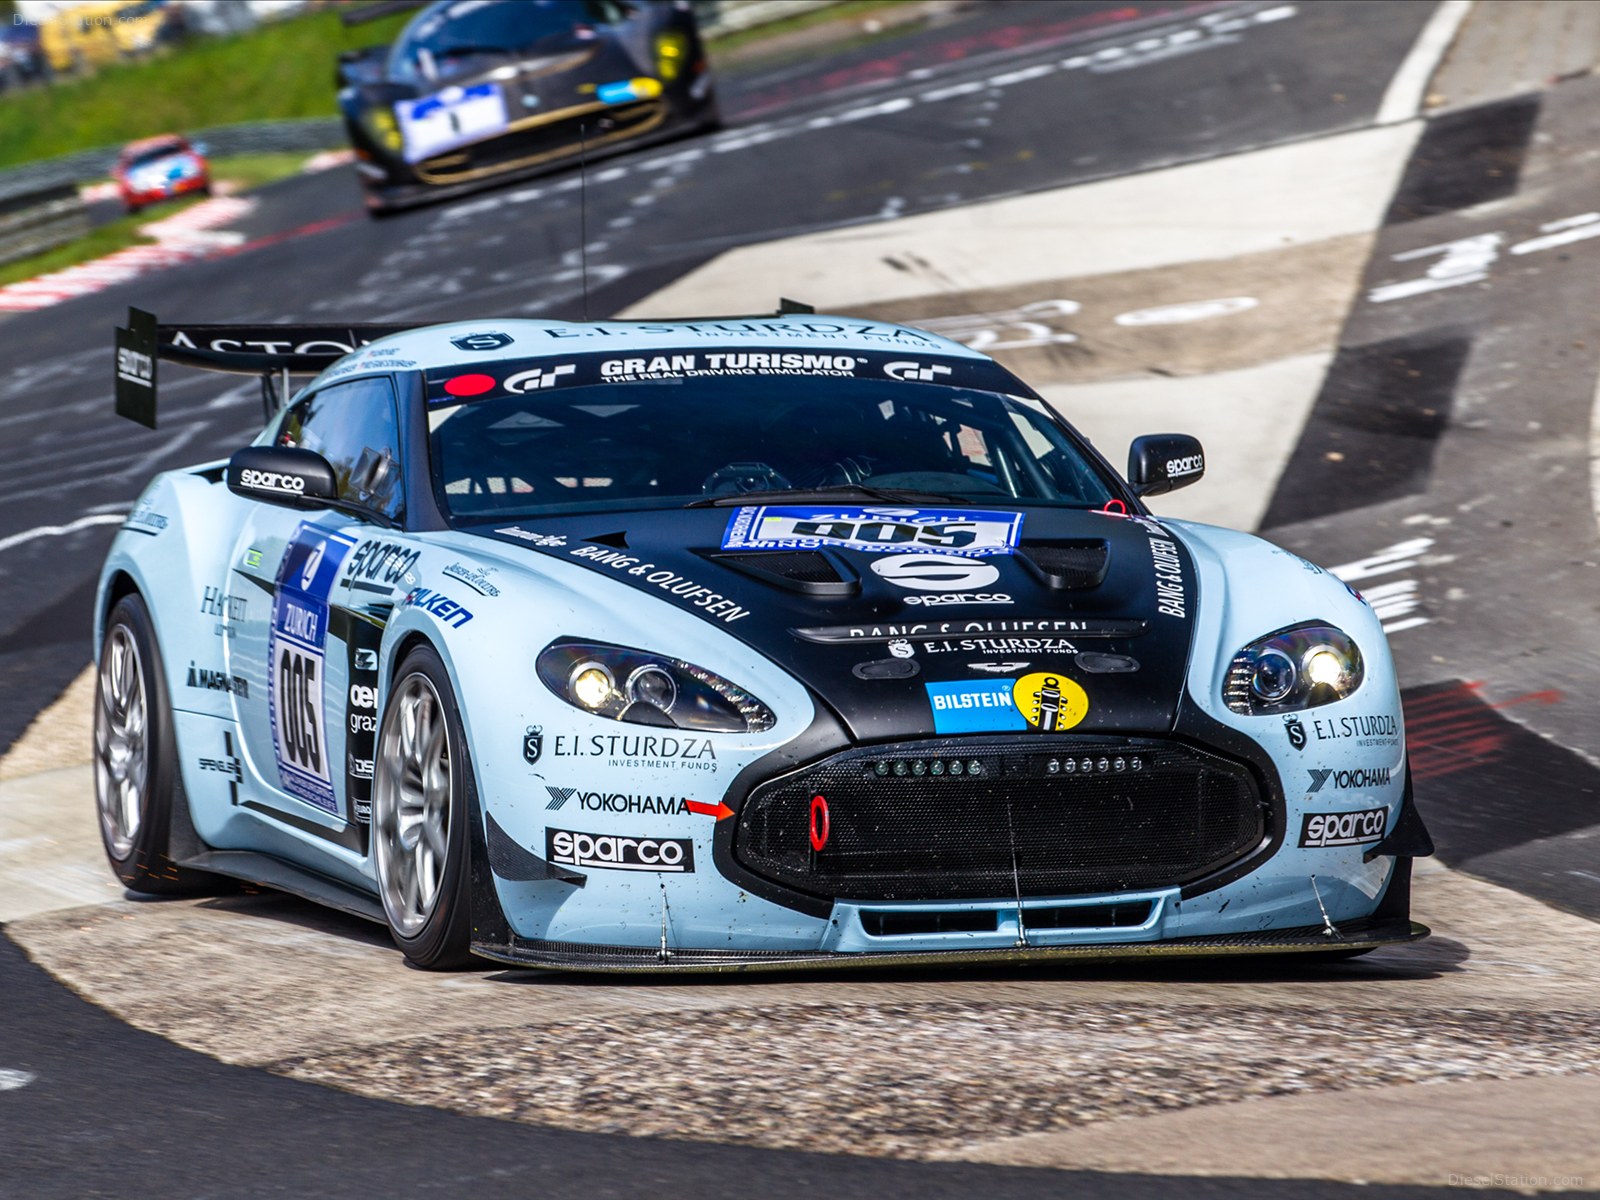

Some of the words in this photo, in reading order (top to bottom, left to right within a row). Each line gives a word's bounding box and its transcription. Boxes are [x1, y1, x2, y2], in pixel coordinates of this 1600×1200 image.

[637, 323, 932, 342] STURDZA
[696, 332, 848, 340] INVESTMENT
[864, 335, 942, 349] FUNDS
[601, 355, 695, 376] GRAN
[601, 375, 637, 383] THE
[640, 371, 684, 380] REAL
[686, 367, 755, 377] DRIVING
[758, 368, 855, 377] SIMULATOR
[1166, 454, 1203, 477] sparco
[240, 468, 305, 493] sparco
[347, 540, 421, 589] sparco
[570, 545, 639, 569] BANG
[628, 563, 655, 576] &
[646, 570, 750, 623] OLUFSEN
[1155, 572, 1183, 583] &
[402, 587, 474, 629] FALKEN
[903, 592, 1014, 607] sparco
[1156, 581, 1185, 618] BANG
[284, 603, 319, 642] ZURICH
[960, 639, 1076, 651] STURDZA
[1047, 647, 1079, 655] FUNDS
[280, 647, 320, 774] 005
[1341, 715, 1398, 737] STURDZA
[590, 735, 716, 760] STURDZA
[608, 759, 676, 769] INVESTMENT
[681, 761, 718, 771] FUNDS
[1333, 767, 1390, 789] YOKOHAMA
[577, 791, 692, 815] YOKOHAMA
[1305, 810, 1384, 846] sparco
[553, 831, 684, 868] sparco
